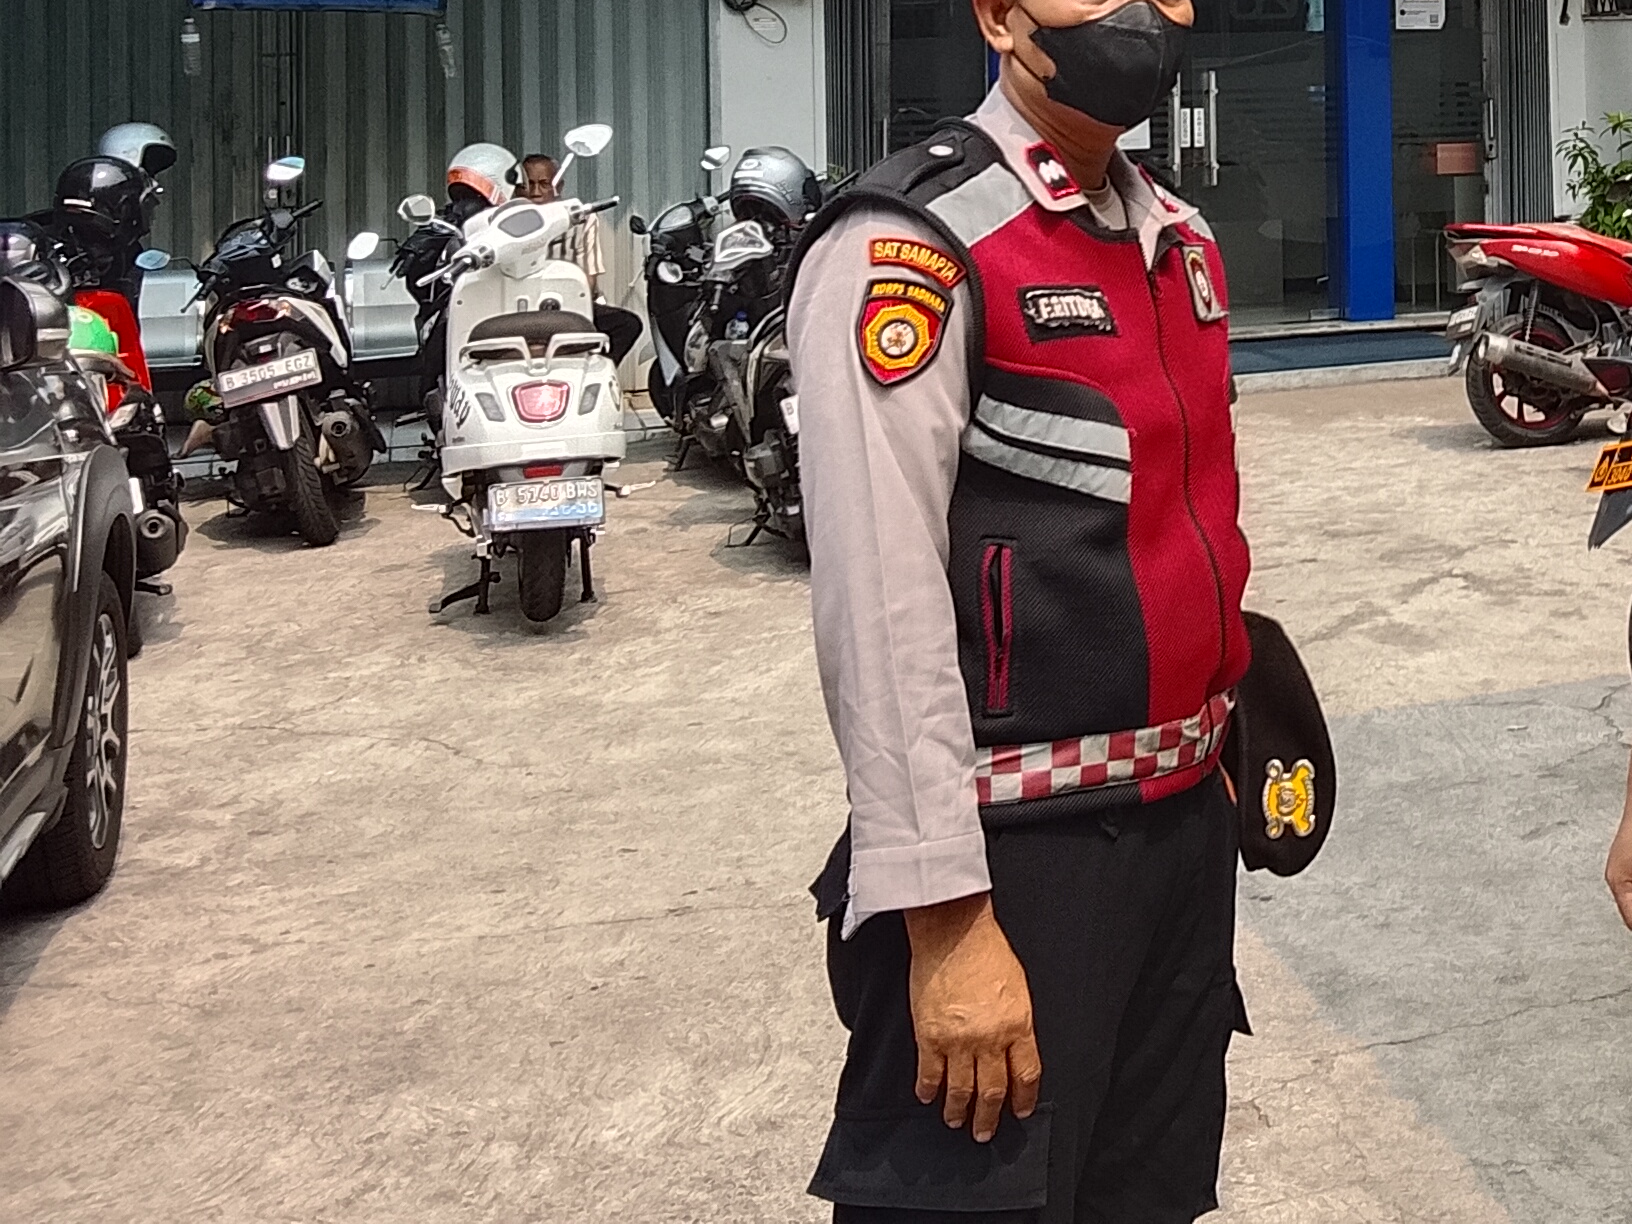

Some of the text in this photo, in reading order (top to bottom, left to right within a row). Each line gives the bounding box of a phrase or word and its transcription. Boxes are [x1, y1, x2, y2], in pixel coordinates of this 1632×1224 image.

[874, 242, 958, 281] SAT SAMAPTA
[225, 376, 235, 389] B
[285, 355, 311, 373] EGZ
